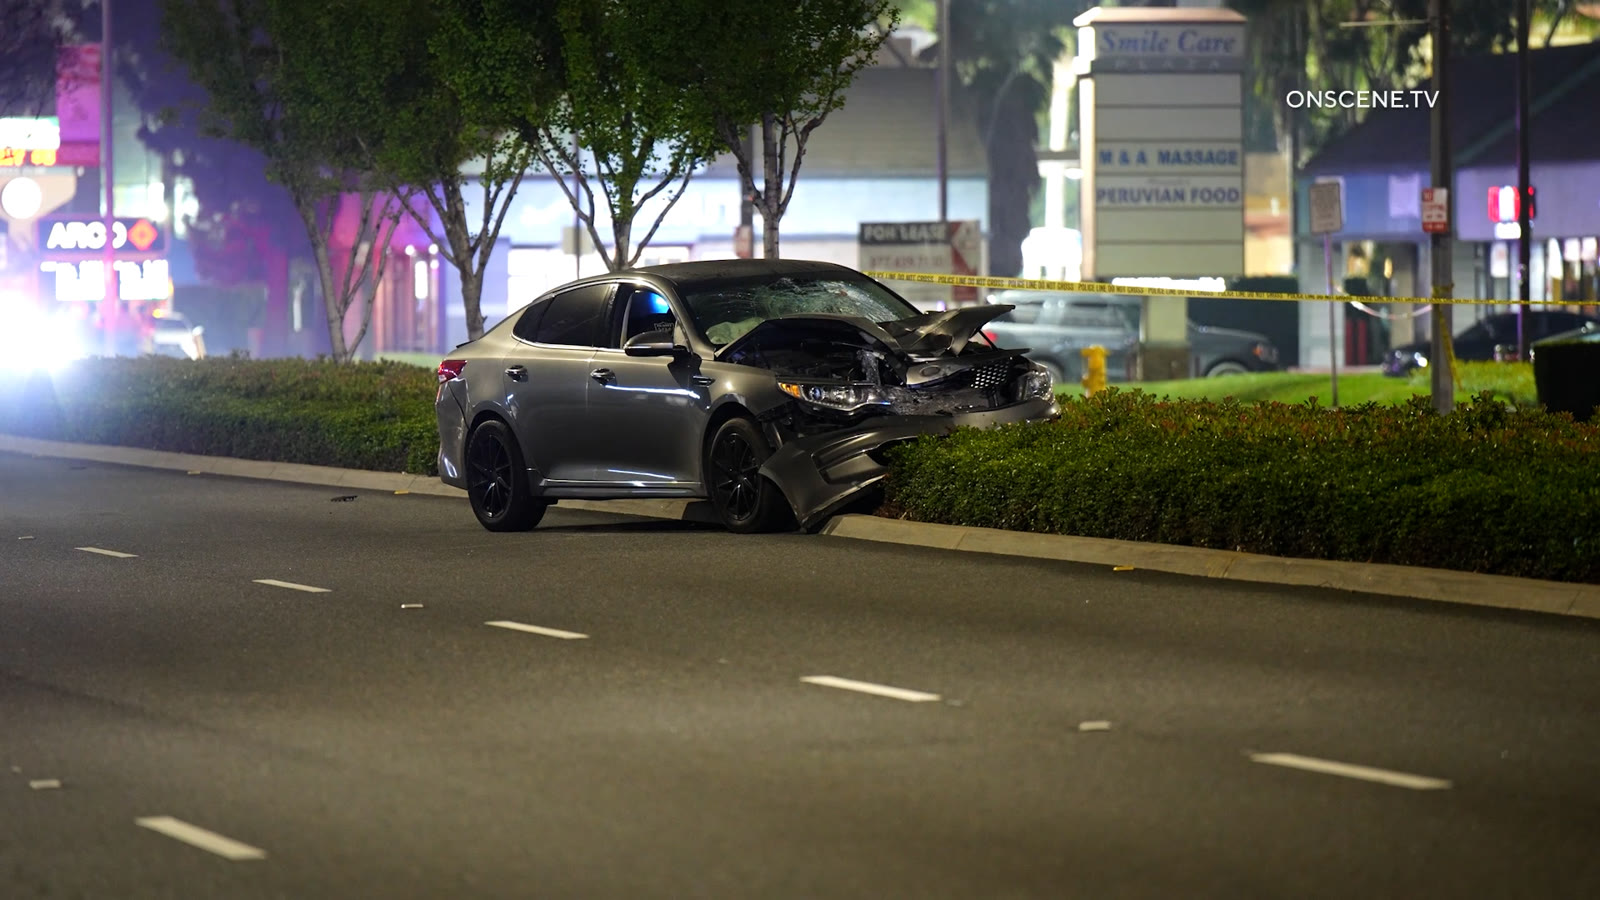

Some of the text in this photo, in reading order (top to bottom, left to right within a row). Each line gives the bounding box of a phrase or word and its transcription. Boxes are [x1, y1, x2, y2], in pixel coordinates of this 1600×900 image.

[1099, 28, 1236, 53] Smile Care
[1099, 149, 1239, 166] M & A MASSAGE
[1096, 187, 1240, 203] PERUVIAN FOOD
[47, 221, 128, 249] ARCO
[864, 222, 946, 241] FOR LEASE
[885, 272, 896, 280] LINE
[917, 274, 934, 283] CROSS
[938, 275, 1004, 287] POLICE LINE DO NOT CROSS
[1008, 280, 1074, 291] POLICE LINE DO NOT CROSS
[1078, 284, 1095, 292] POLICE
[1108, 285, 1115, 293] DO
[1116, 286, 1126, 294] NOT
[1148, 287, 1164, 295] POLICE
